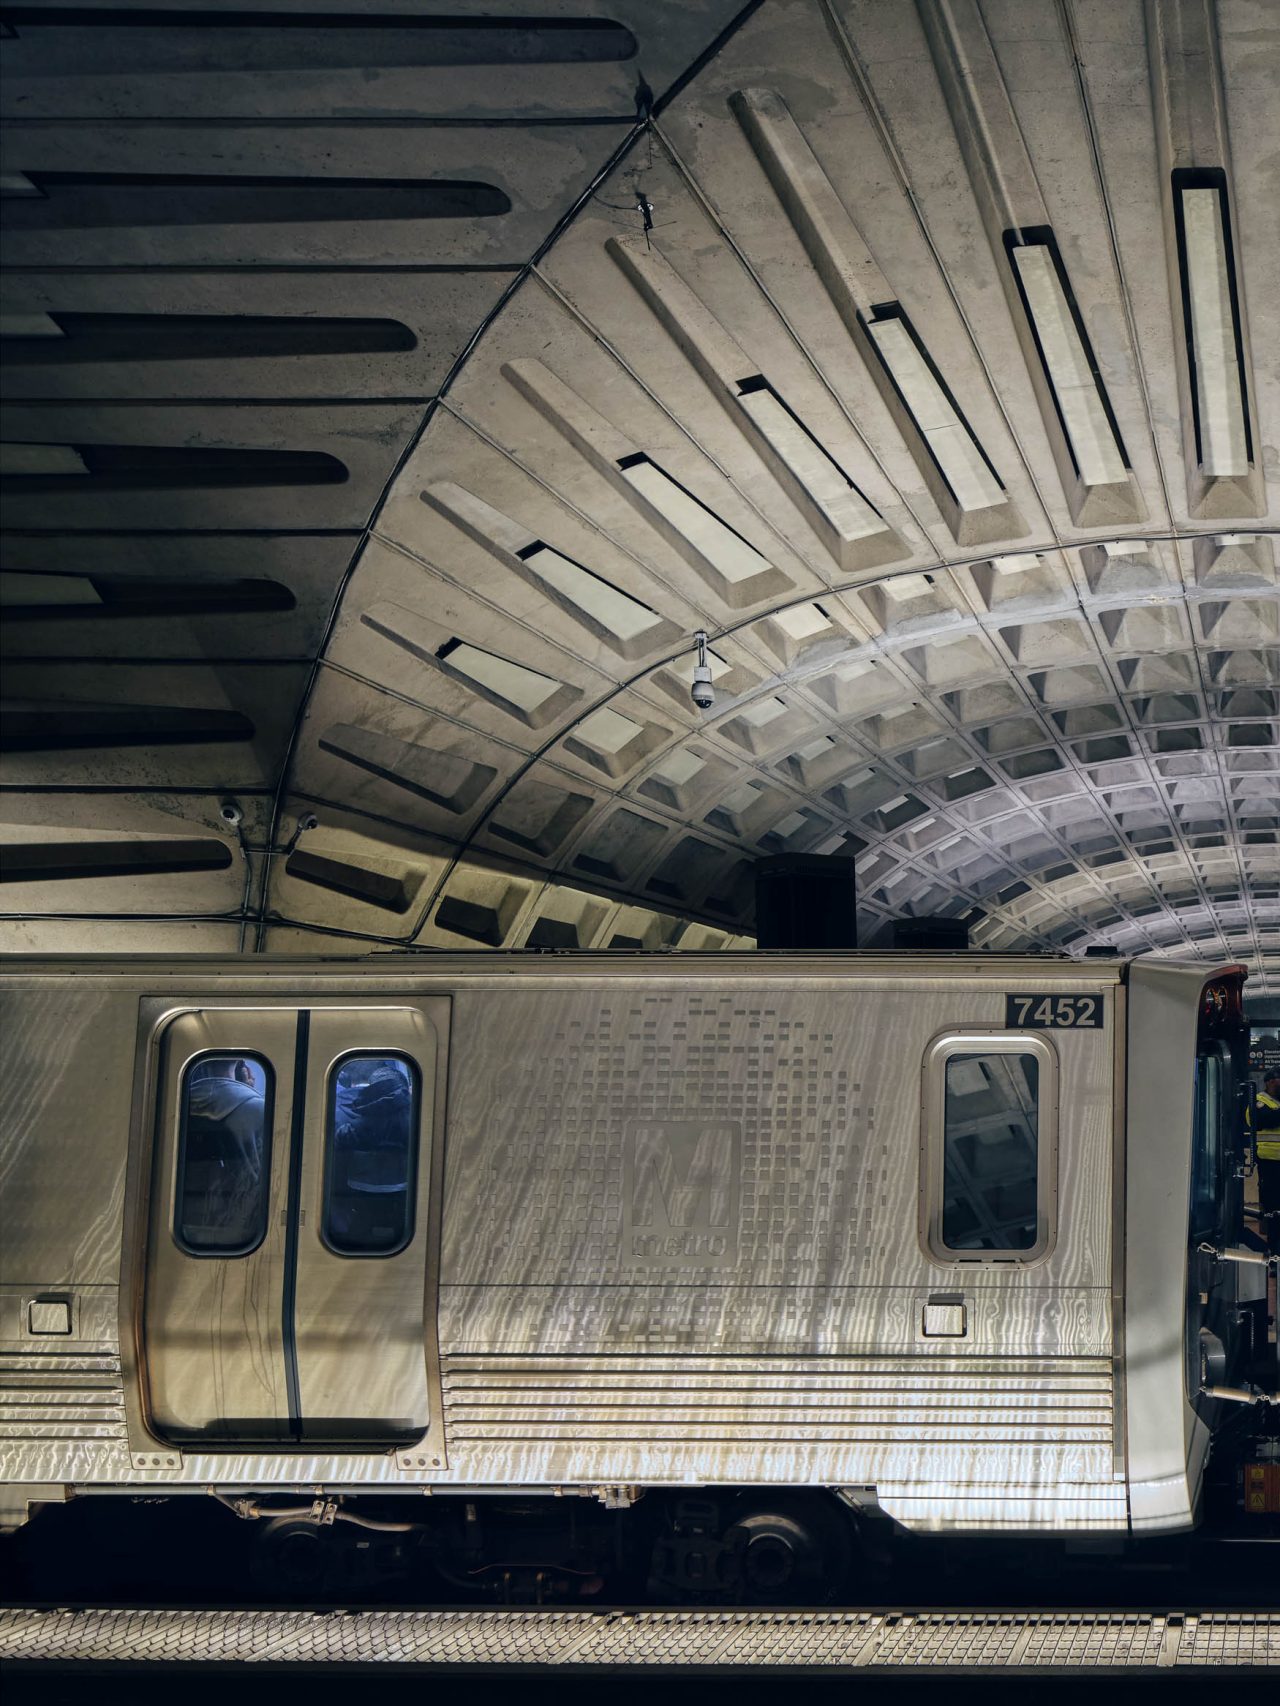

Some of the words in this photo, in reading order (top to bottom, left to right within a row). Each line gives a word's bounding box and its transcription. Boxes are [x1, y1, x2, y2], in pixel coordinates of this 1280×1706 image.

[1014, 998, 1095, 1026] 7452
[632, 1129, 731, 1227] M
[631, 1231, 726, 1257] metro
